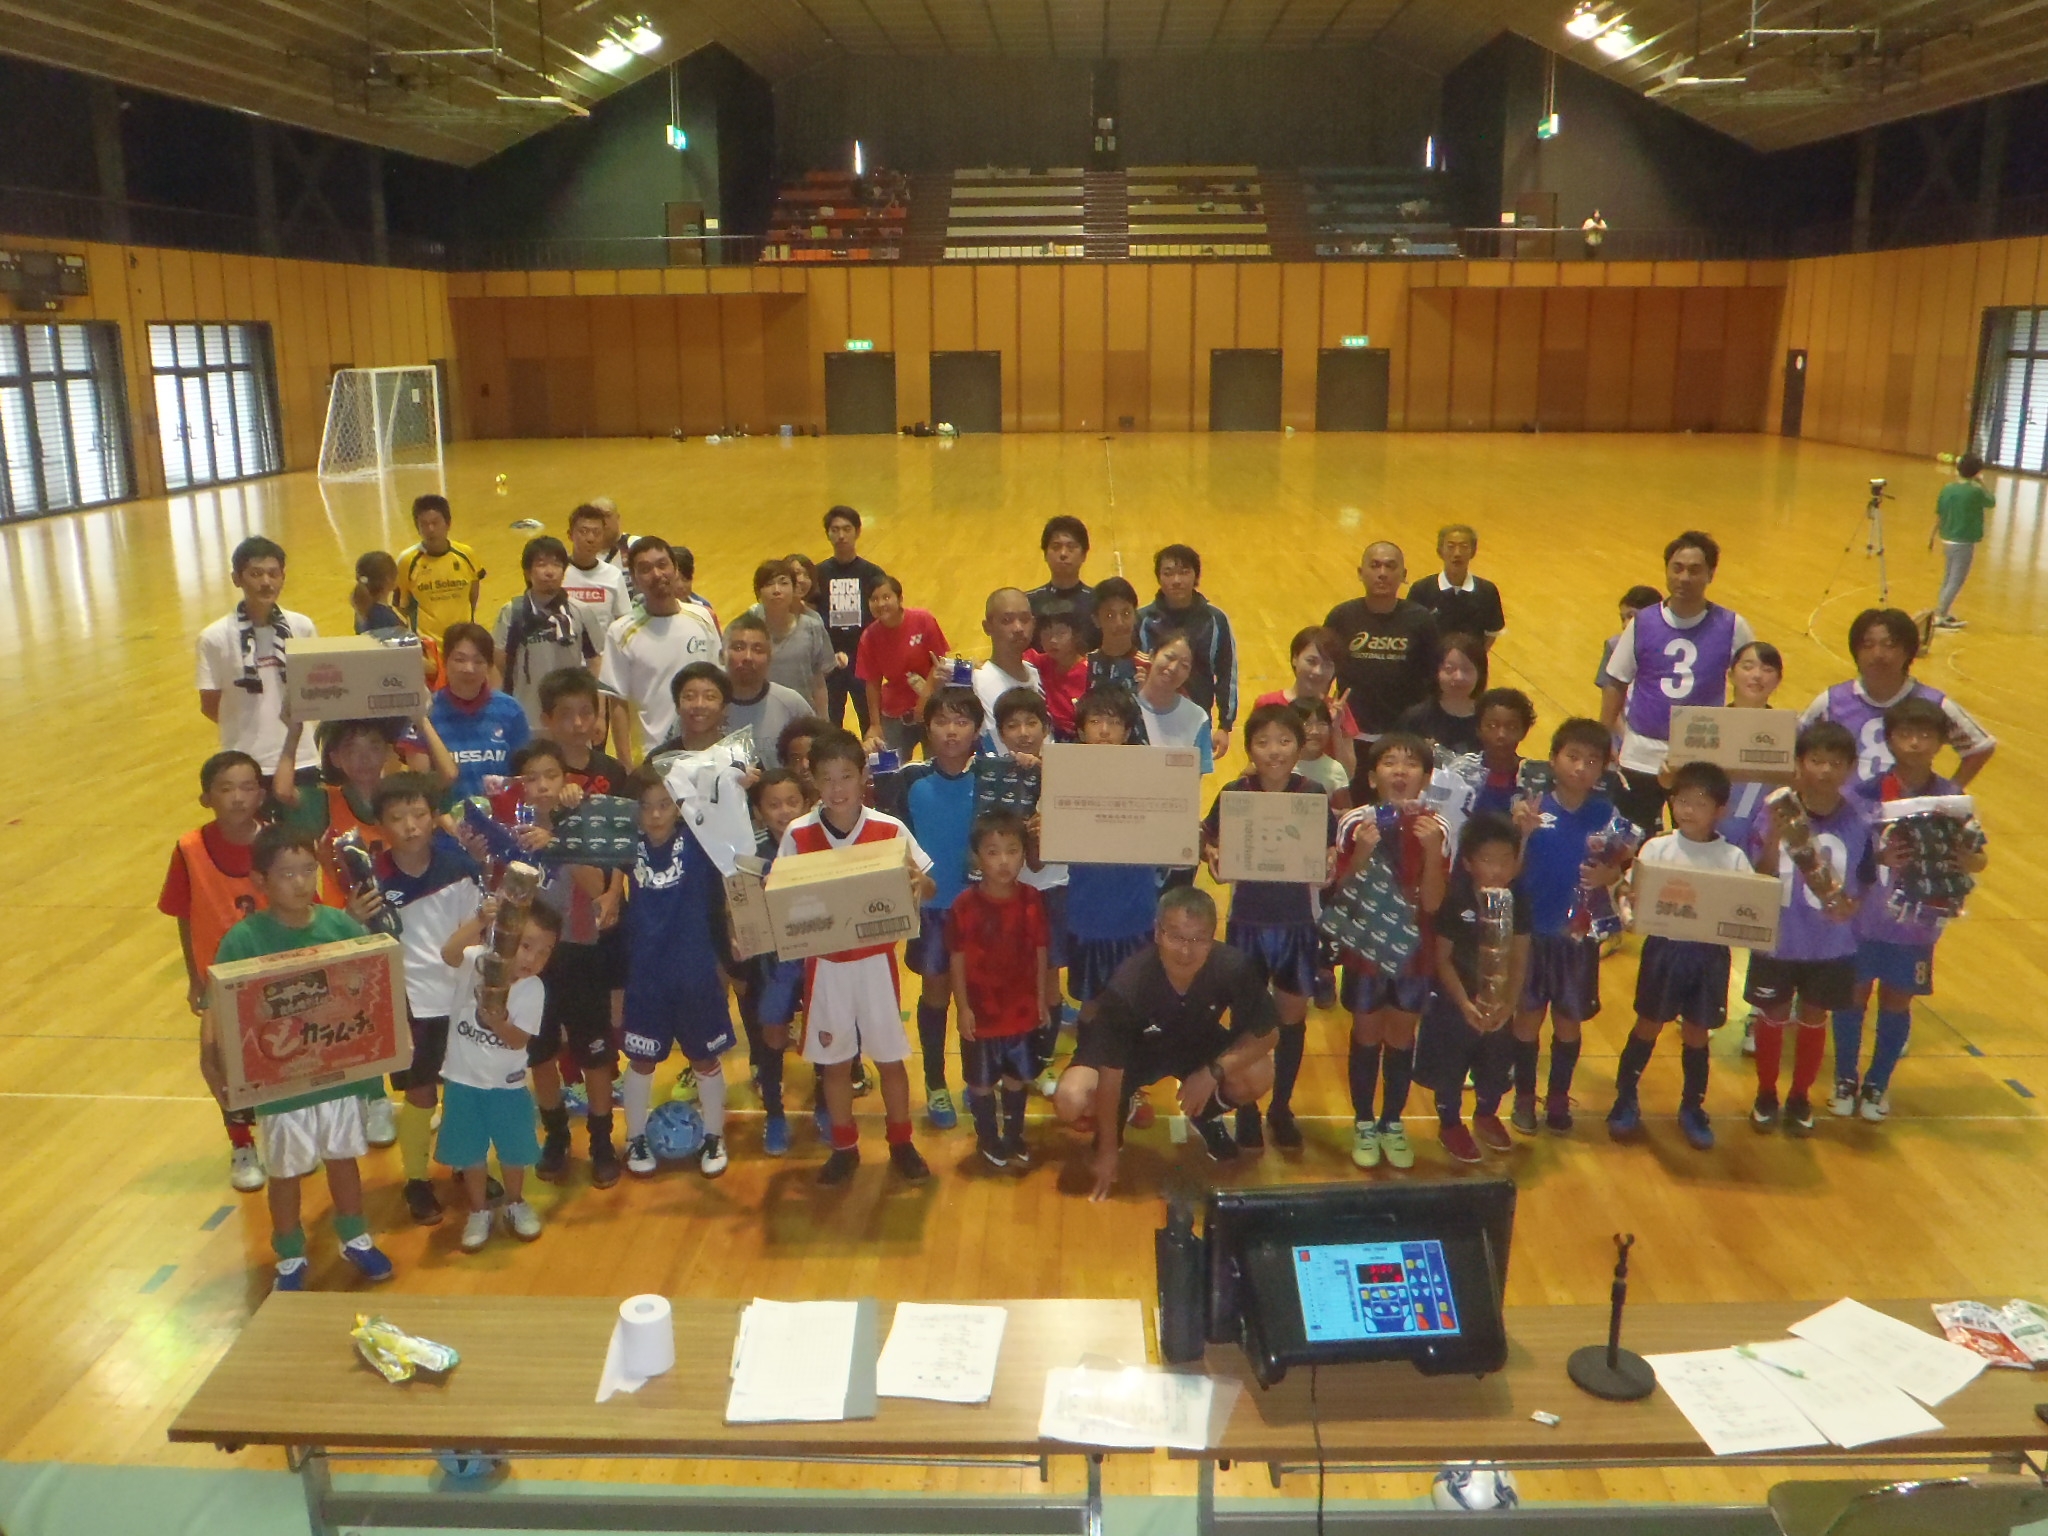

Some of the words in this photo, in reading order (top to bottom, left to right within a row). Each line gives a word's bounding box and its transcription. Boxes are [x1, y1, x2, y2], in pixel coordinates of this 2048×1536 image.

[1368, 636, 1408, 650] asics
[1660, 638, 1697, 698] 3
[450, 750, 507, 763] ISSAN
[868, 901, 892, 914] 60g
[1914, 961, 1930, 985] 8
